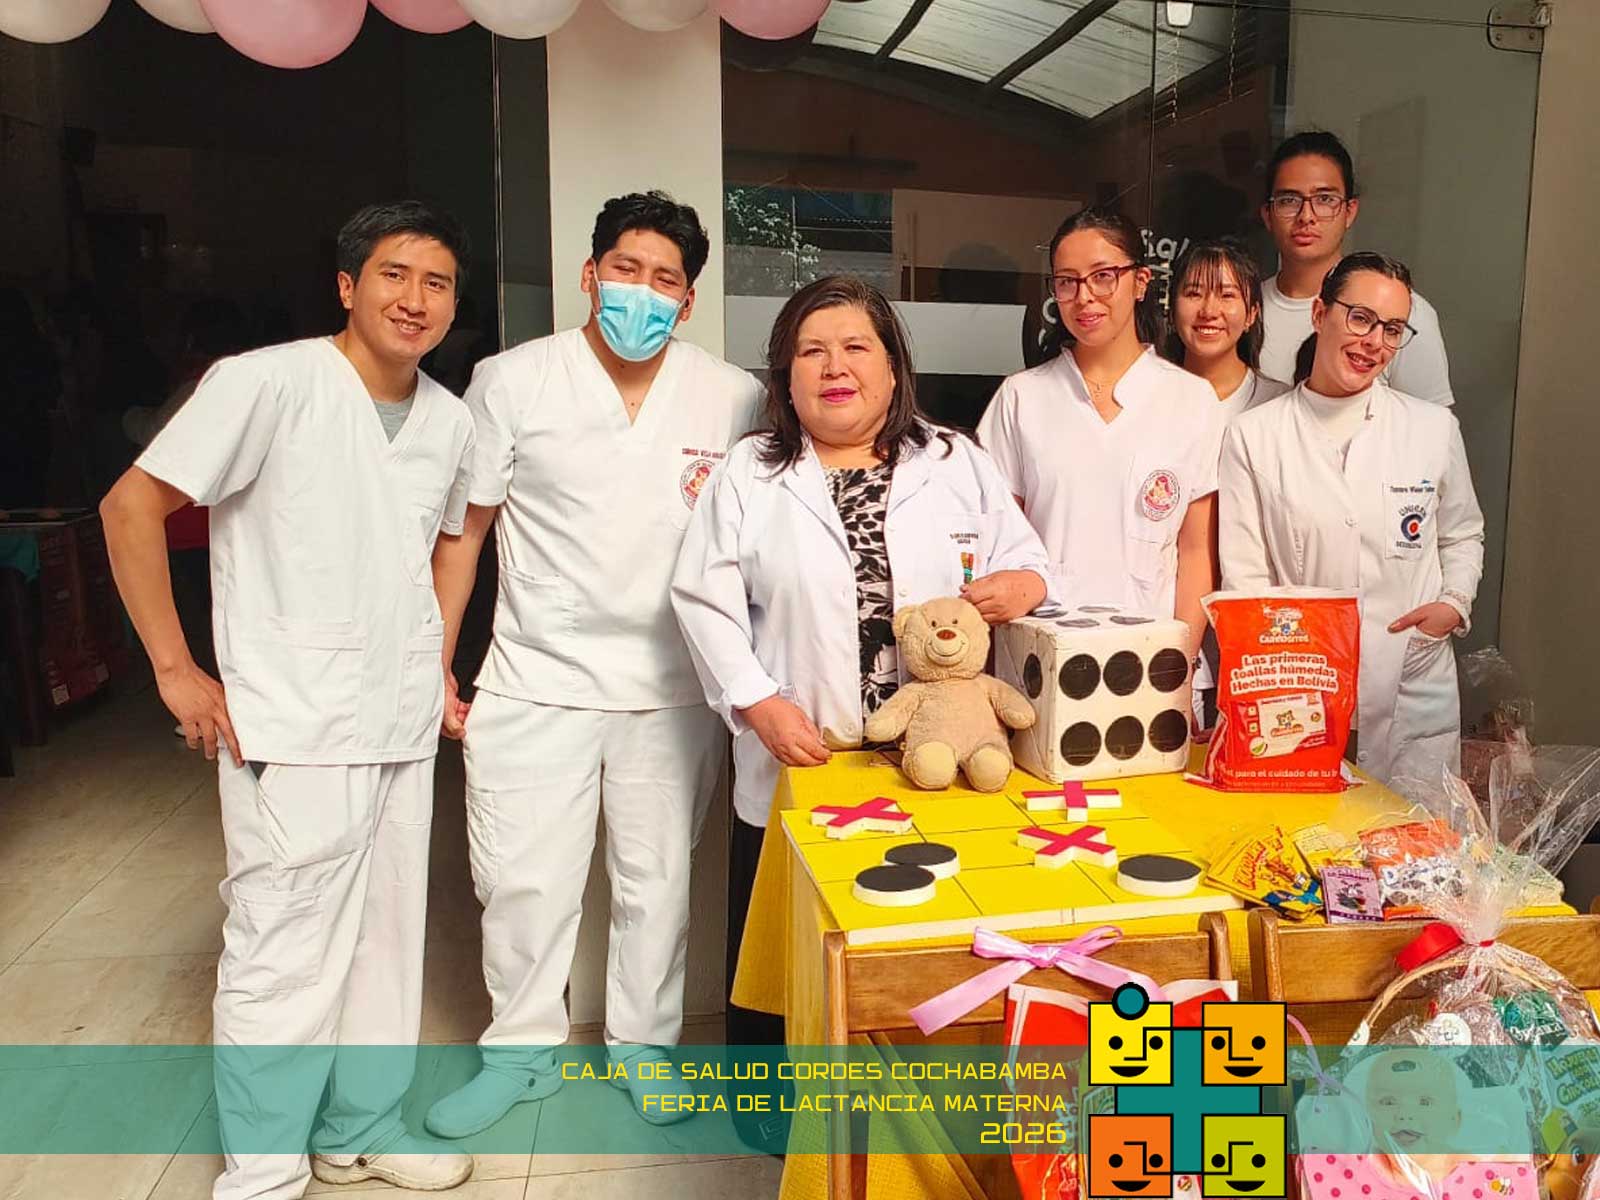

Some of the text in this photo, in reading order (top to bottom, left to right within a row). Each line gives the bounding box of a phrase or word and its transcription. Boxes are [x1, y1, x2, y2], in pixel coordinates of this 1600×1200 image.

[1244, 653, 1325, 666] Las primeras
[1233, 666, 1277, 680] toallas
[1232, 679, 1277, 692] Hechas
[1297, 676, 1337, 688] Bolivia
